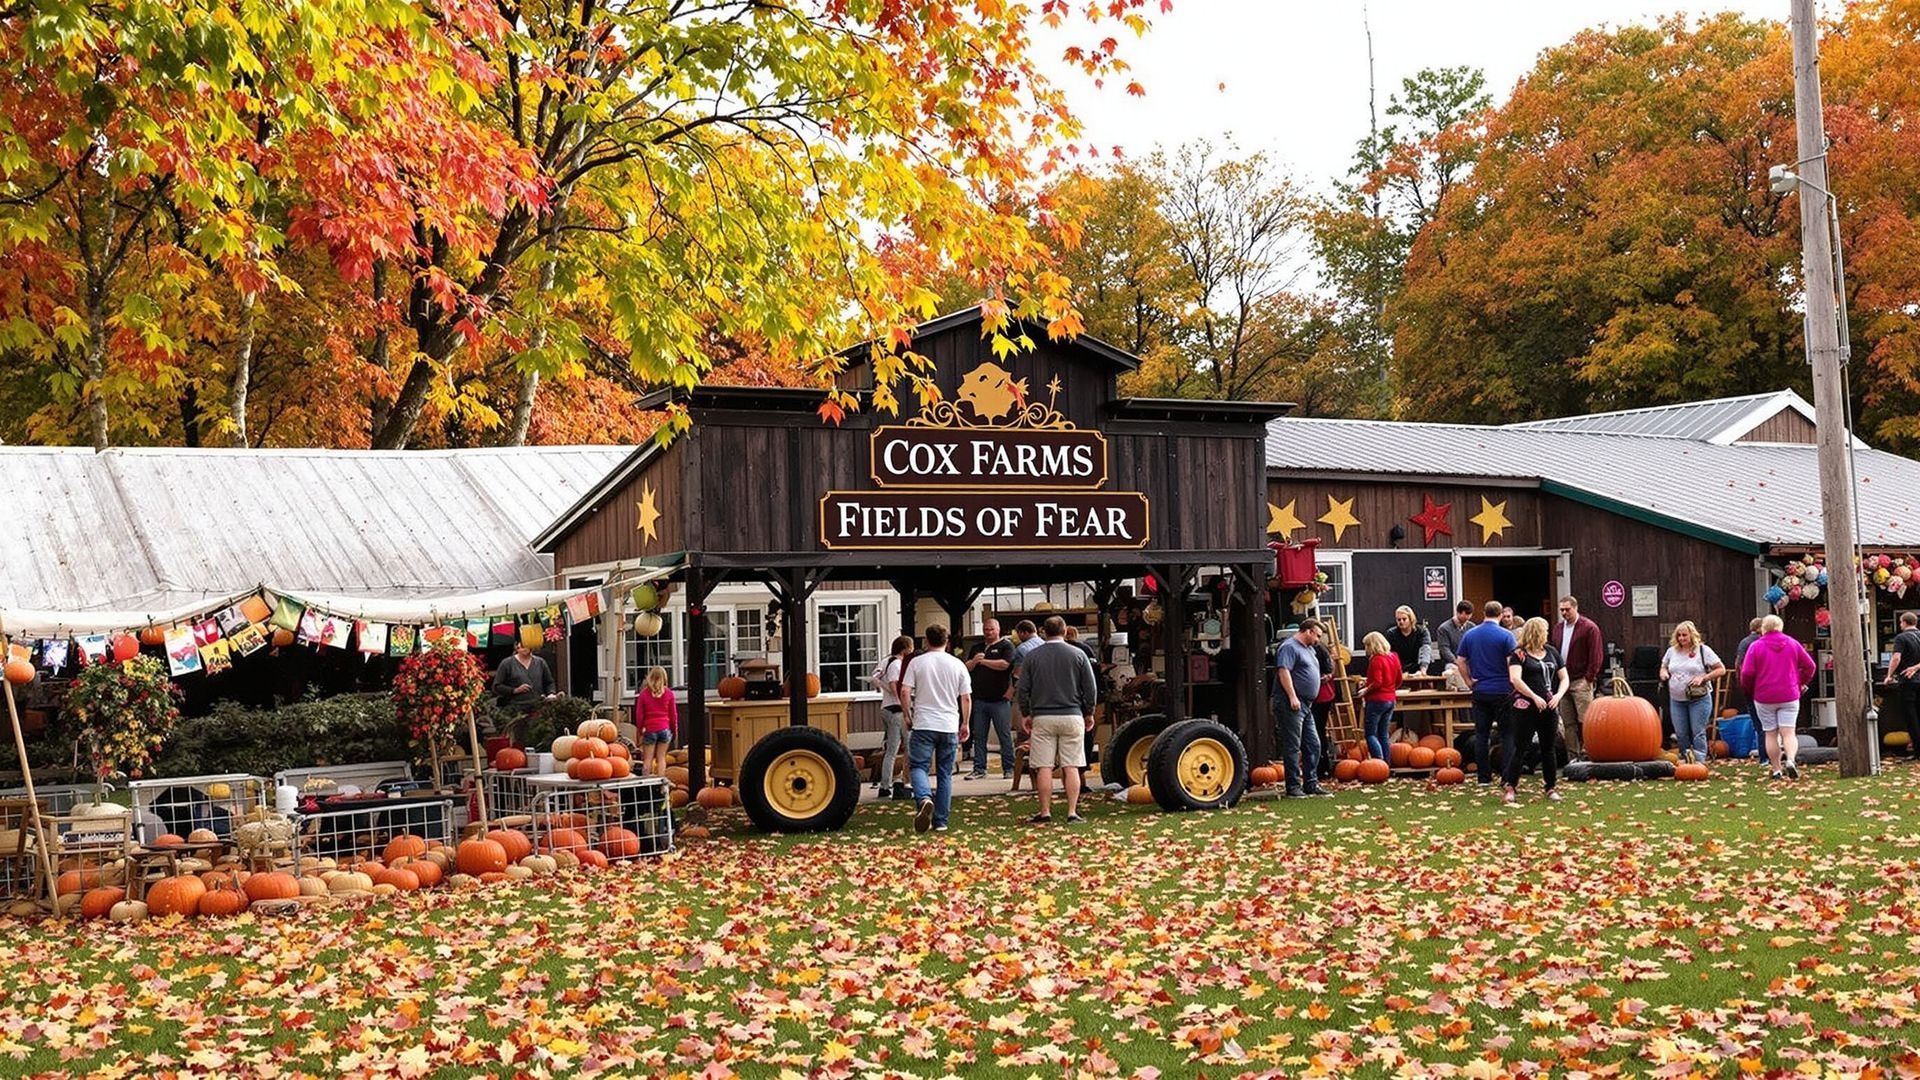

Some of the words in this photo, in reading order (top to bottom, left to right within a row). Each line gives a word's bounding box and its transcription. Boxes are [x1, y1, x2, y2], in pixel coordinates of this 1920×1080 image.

[883, 439, 962, 475] COX
[970, 440, 1094, 477] FARMS
[837, 502, 966, 537] FIELDS
[976, 507, 1023, 537] OF
[1035, 502, 1133, 540] FEAR
